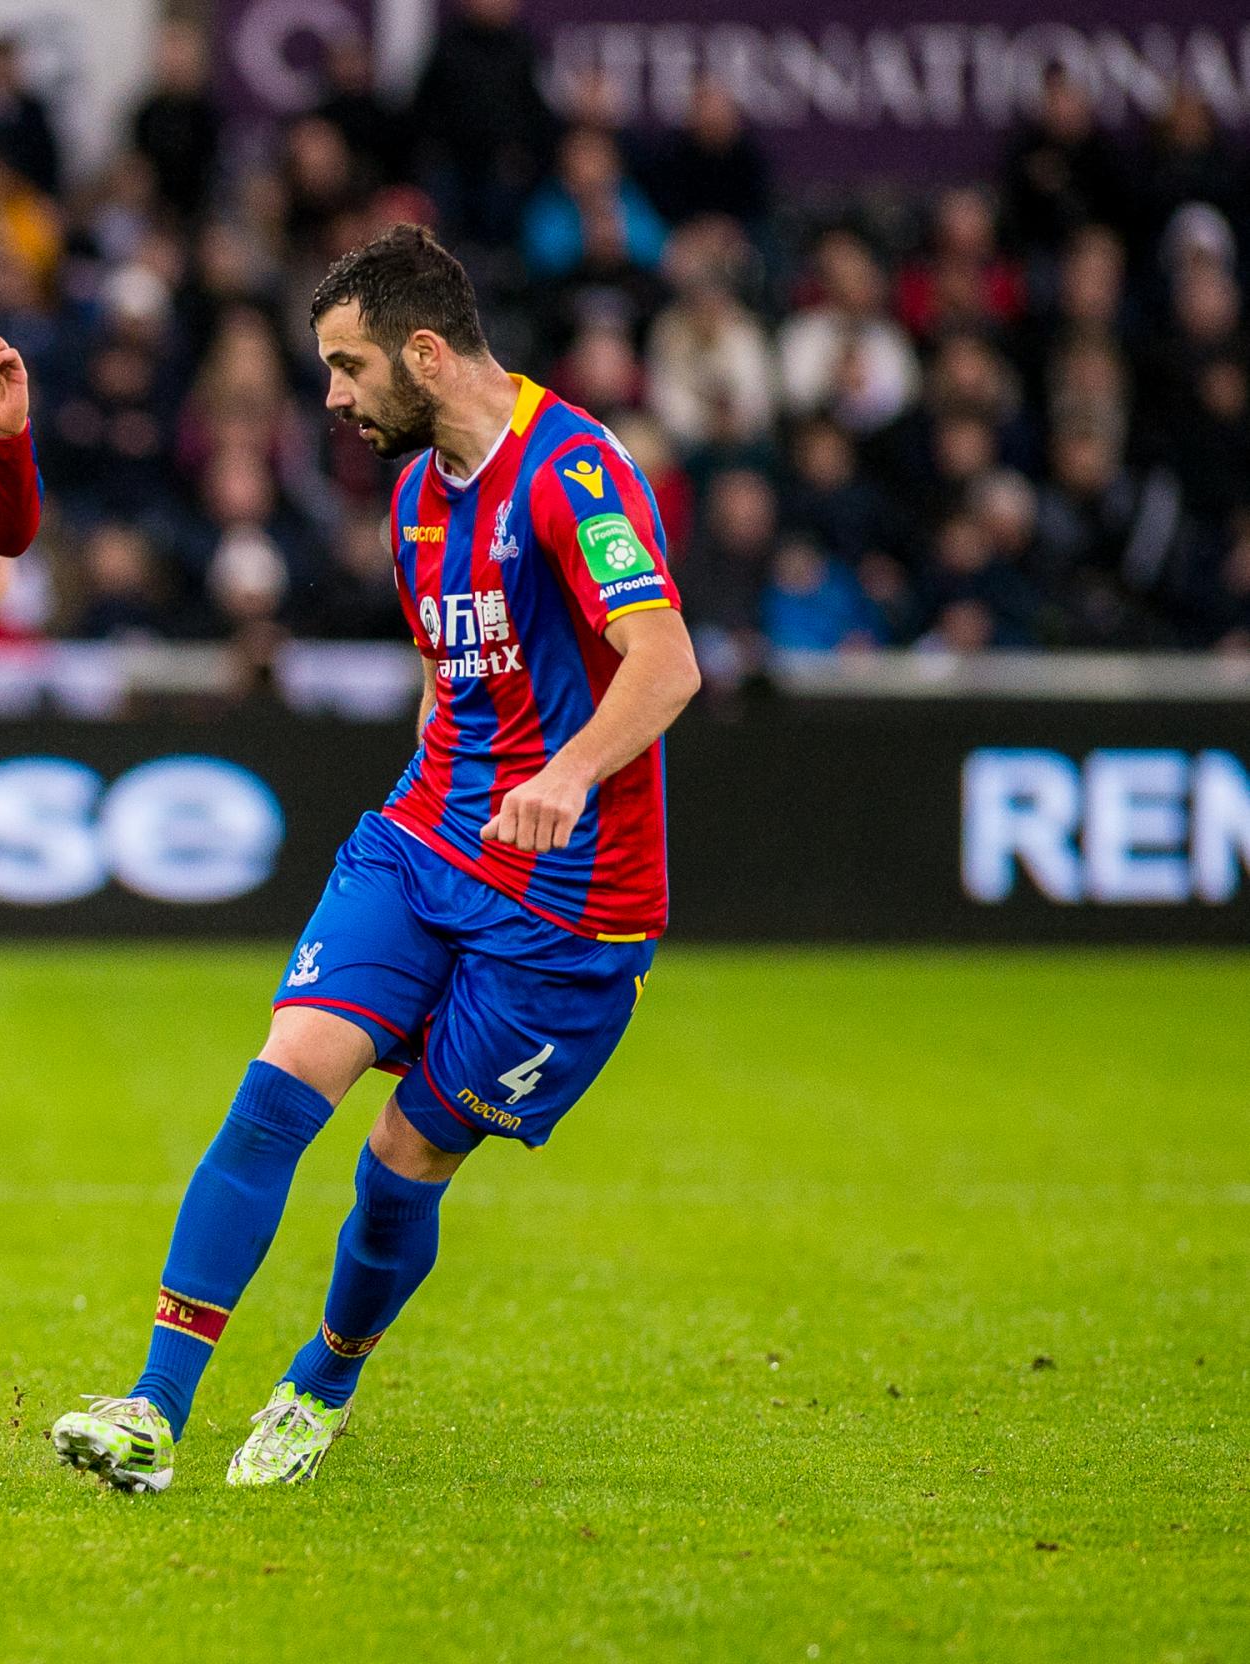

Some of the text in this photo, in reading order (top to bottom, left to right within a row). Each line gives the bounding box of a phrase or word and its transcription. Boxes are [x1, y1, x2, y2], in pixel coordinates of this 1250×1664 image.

[403, 525, 445, 543] macron
[599, 574, 666, 601] All Football
[442, 590, 510, 647] 万博
[437, 644, 523, 678] anBetX
[497, 1043, 555, 1104] 4
[456, 1088, 522, 1131] macron
[156, 1294, 195, 1324] PFC
